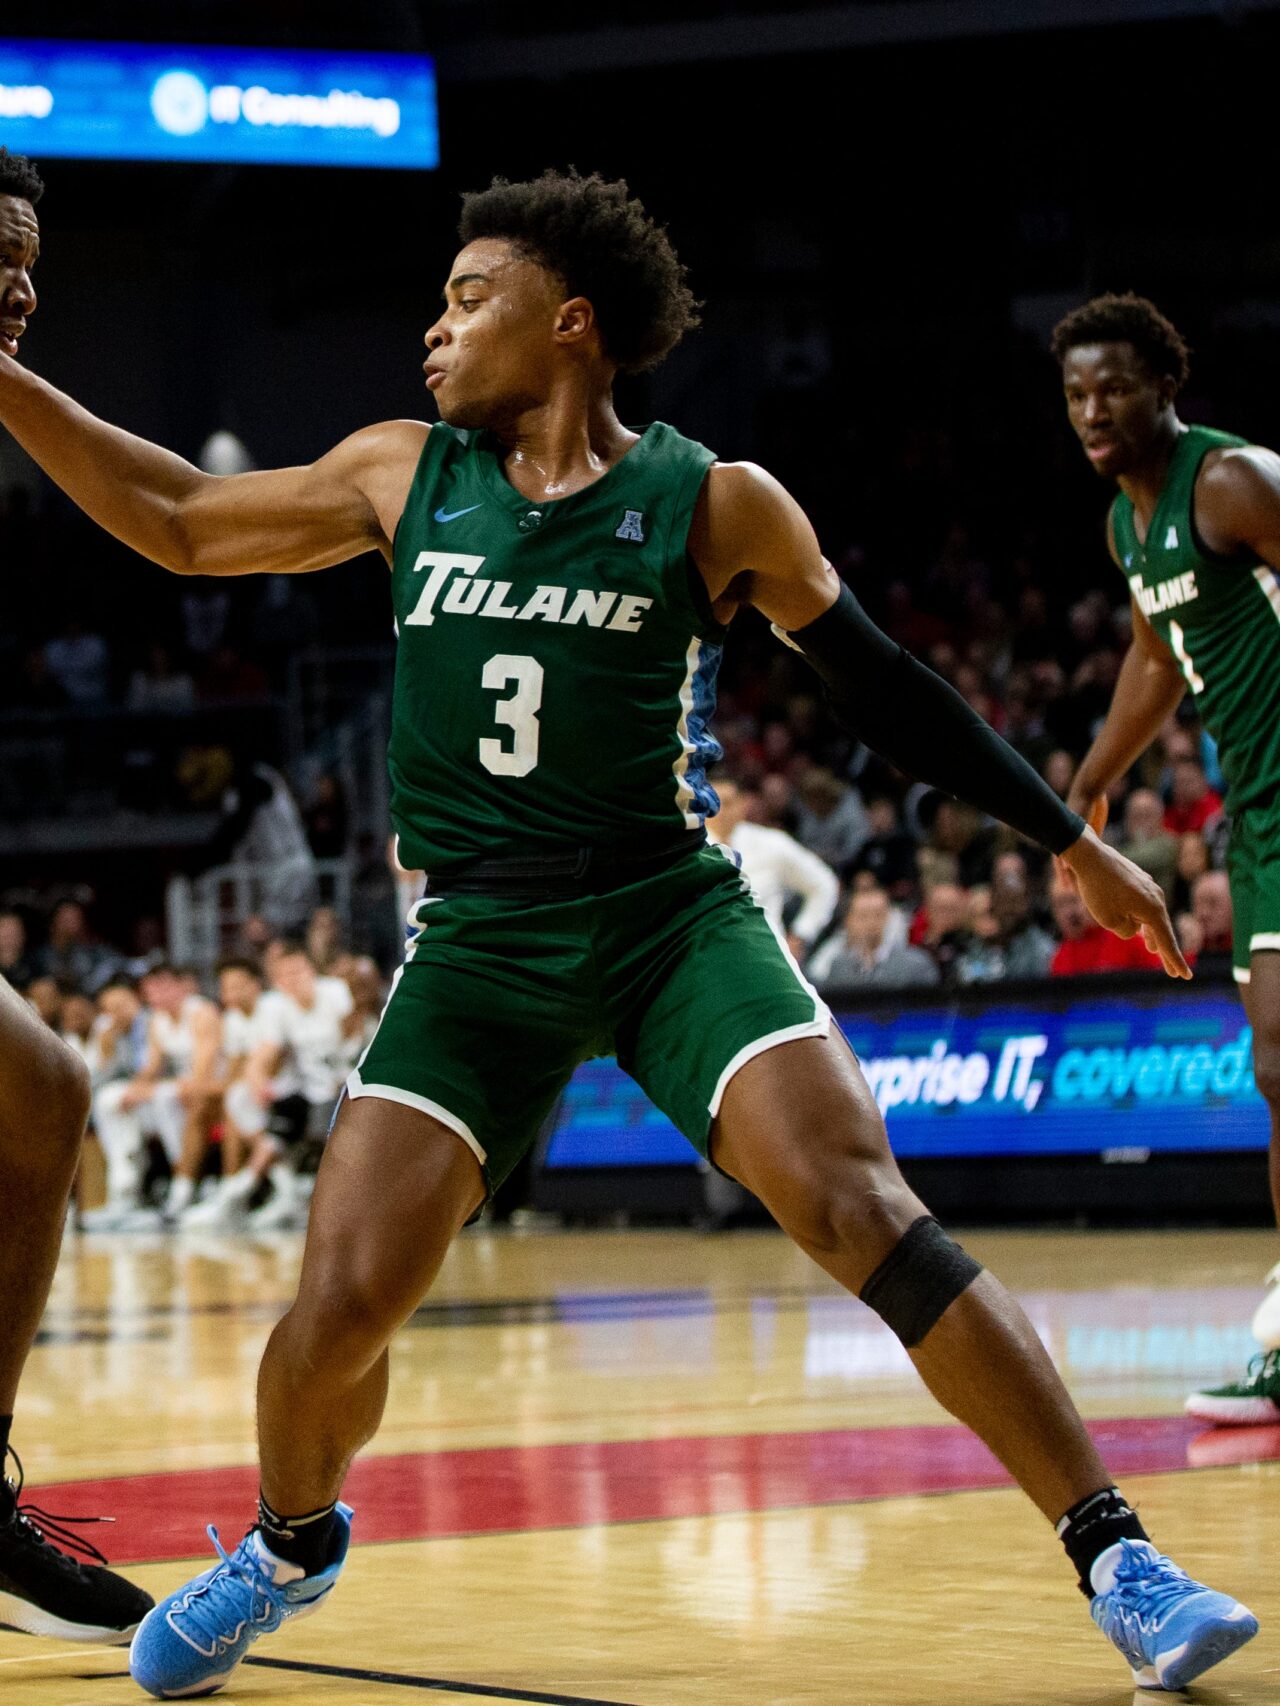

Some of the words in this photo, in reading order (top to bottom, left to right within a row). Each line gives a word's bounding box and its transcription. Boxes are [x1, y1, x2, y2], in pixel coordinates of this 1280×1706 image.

[209, 86, 241, 123] IT
[243, 86, 400, 137] Consulting
[404, 551, 654, 633] TULANE
[479, 653, 545, 778] 3
[860, 1040, 990, 1119] rprise
[992, 1035, 1048, 1113] IT,
[1052, 1025, 1255, 1098] covered.
